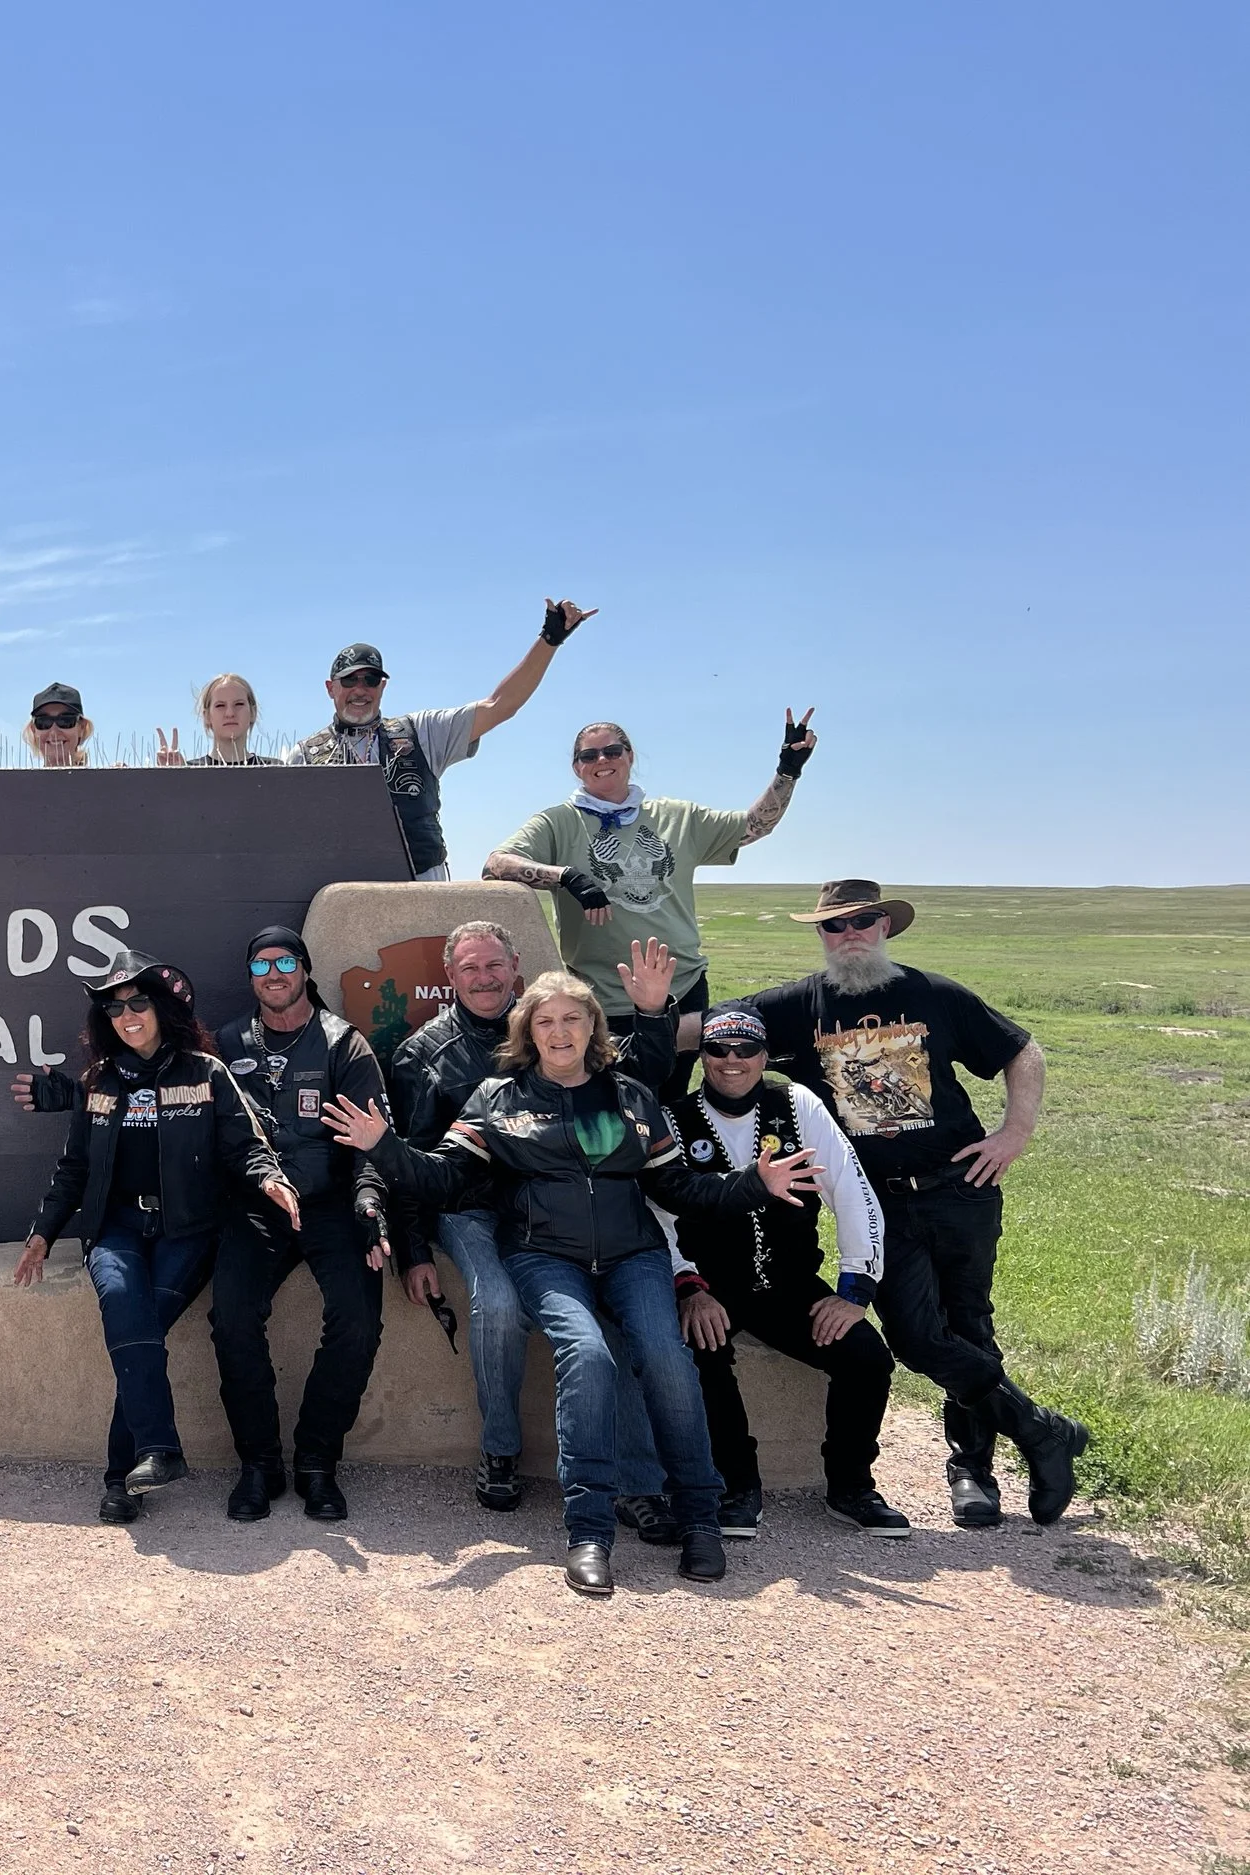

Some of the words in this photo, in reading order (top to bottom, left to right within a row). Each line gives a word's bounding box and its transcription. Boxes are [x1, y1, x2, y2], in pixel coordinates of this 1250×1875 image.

[159, 1082, 210, 1105] DAVIDSON
[161, 1103, 203, 1121] cycles
[859, 1179, 873, 1206] WELL
[868, 1208, 880, 1245] JACOBS
